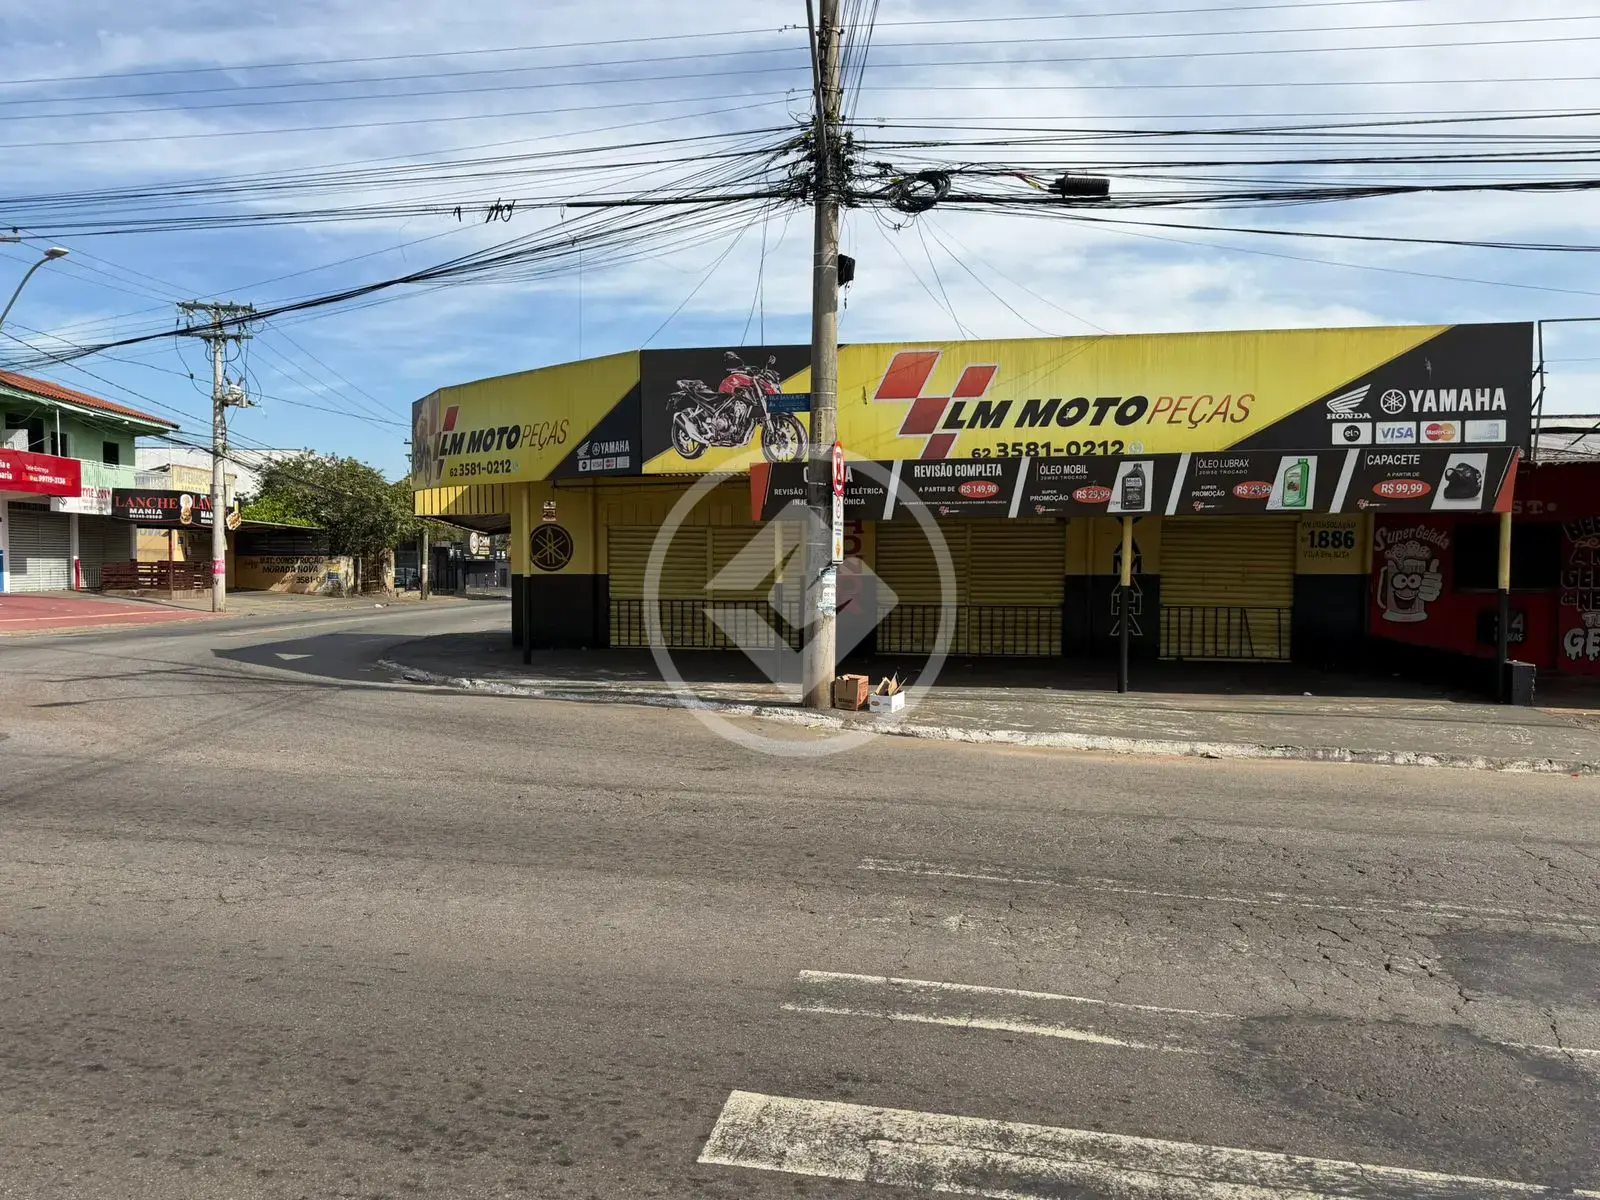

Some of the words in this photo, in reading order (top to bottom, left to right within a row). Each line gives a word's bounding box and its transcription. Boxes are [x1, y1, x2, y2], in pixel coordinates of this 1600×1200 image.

[1409, 388, 1507, 413] YAMAHA
[941, 399, 1013, 430] LM
[1326, 412, 1372, 420] HONDA
[1381, 427, 1414, 440] VISA
[440, 432, 467, 456] LM
[600, 440, 630, 455] YAMAHA
[971, 447, 992, 458] 62
[996, 440, 1125, 457] 3581-0212
[1198, 458, 1219, 469] ÓLEO
[1220, 459, 1249, 468] LUBRAX
[1366, 454, 1420, 465] CAPACETE
[458, 459, 512, 477] 3581-0212
[914, 462, 953, 478] REVISÃO
[954, 463, 1002, 477] COMPLETA
[1040, 463, 1062, 475] ÓLEO
[1063, 464, 1088, 474] MOBIL
[774, 487, 804, 496] REVISÃO
[850, 487, 884, 496] ELÉTRICA
[961, 485, 971, 494] R$
[972, 484, 997, 495] 149,90
[1076, 490, 1087, 499] R$
[1191, 490, 1226, 498] PROMOÇÃO
[1236, 485, 1248, 495] R$
[1381, 484, 1393, 494] R$
[1396, 484, 1423, 495] 99,99
[115, 495, 178, 509] LANCHE
[1309, 530, 1355, 549] 1.886
[298, 564, 319, 573] NOVA
